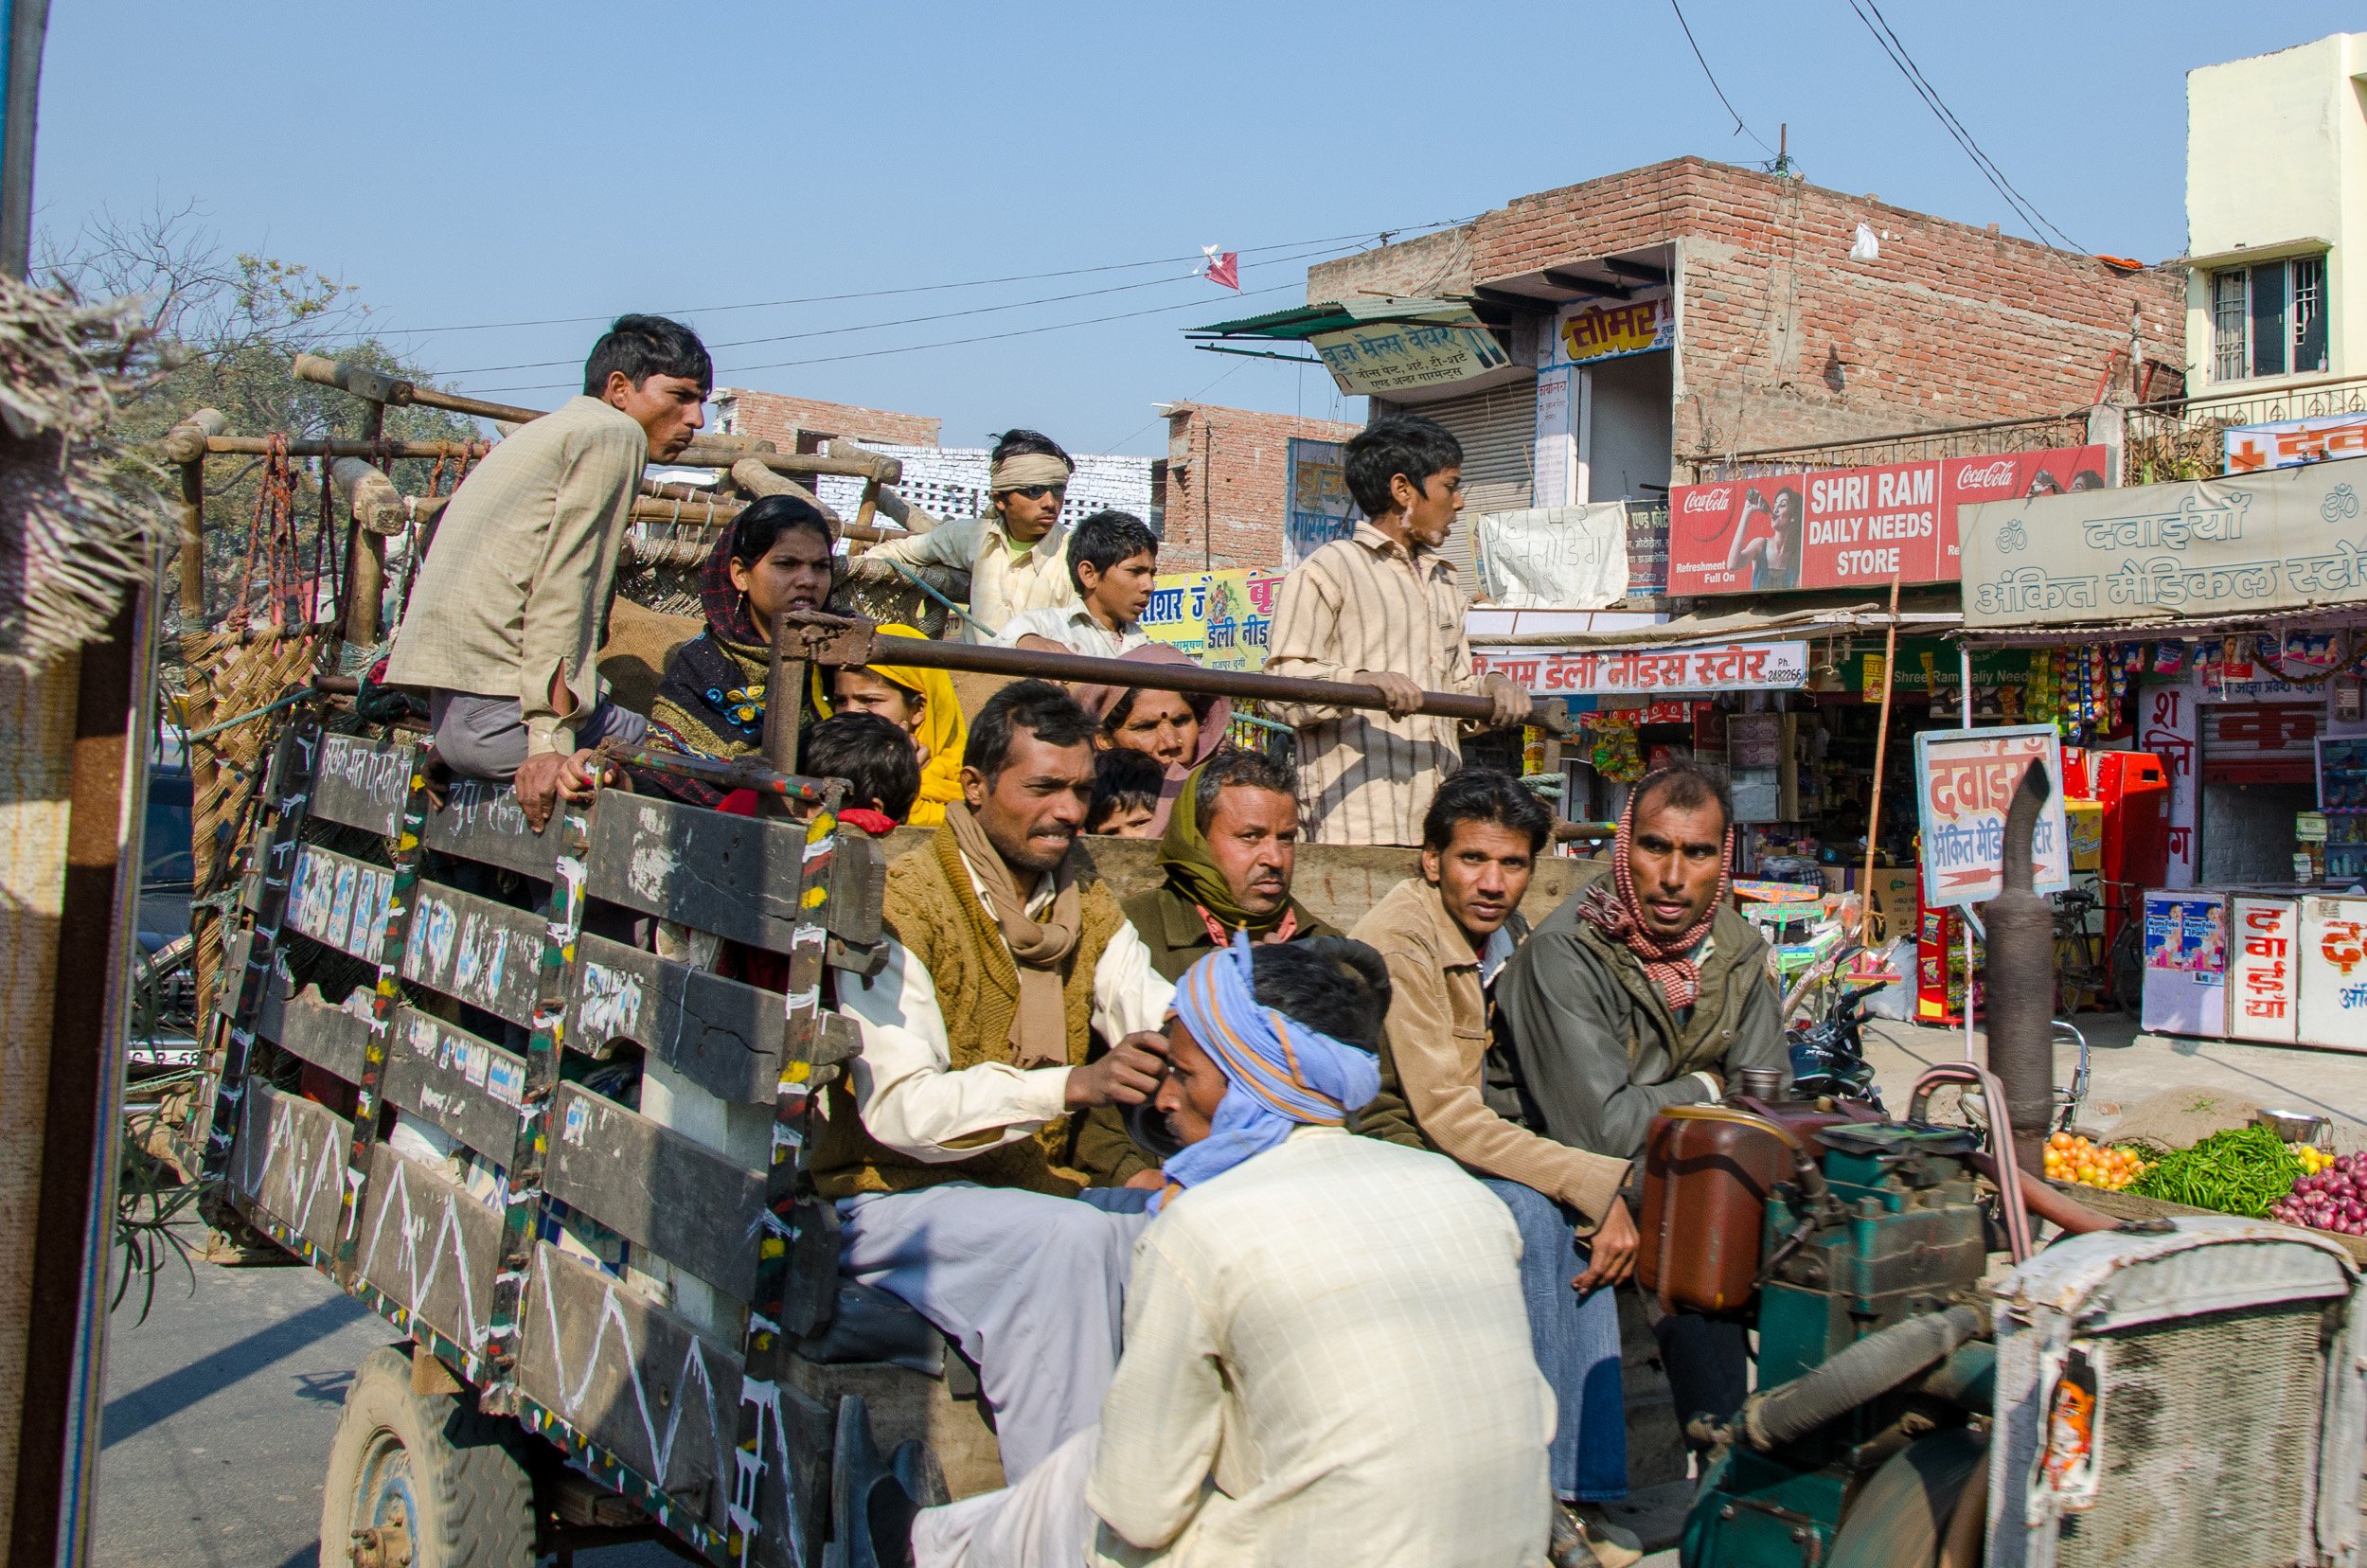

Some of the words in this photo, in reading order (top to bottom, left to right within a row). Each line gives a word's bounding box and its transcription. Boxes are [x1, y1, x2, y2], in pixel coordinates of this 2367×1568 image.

[1562, 299, 1659, 359] तोमर
[1810, 475, 1870, 515] SHRI
[1878, 468, 1934, 508] RAM
[1808, 518, 1862, 545] DAILY
[1868, 510, 1933, 541] NEEDS
[1676, 561, 1726, 574] Refreshment
[1703, 573, 1721, 584] Full
[1722, 572, 1735, 582] On
[1836, 546, 1901, 577] STORE
[1975, 566, 2097, 615] अंकित
[1207, 616, 1237, 649] डेली
[1241, 614, 1271, 651] नीड्
[1545, 653, 1600, 689] डेली
[1695, 645, 1771, 685] स्टोर
[1934, 669, 1959, 683] Ram
[1972, 669, 1993, 686] aliy
